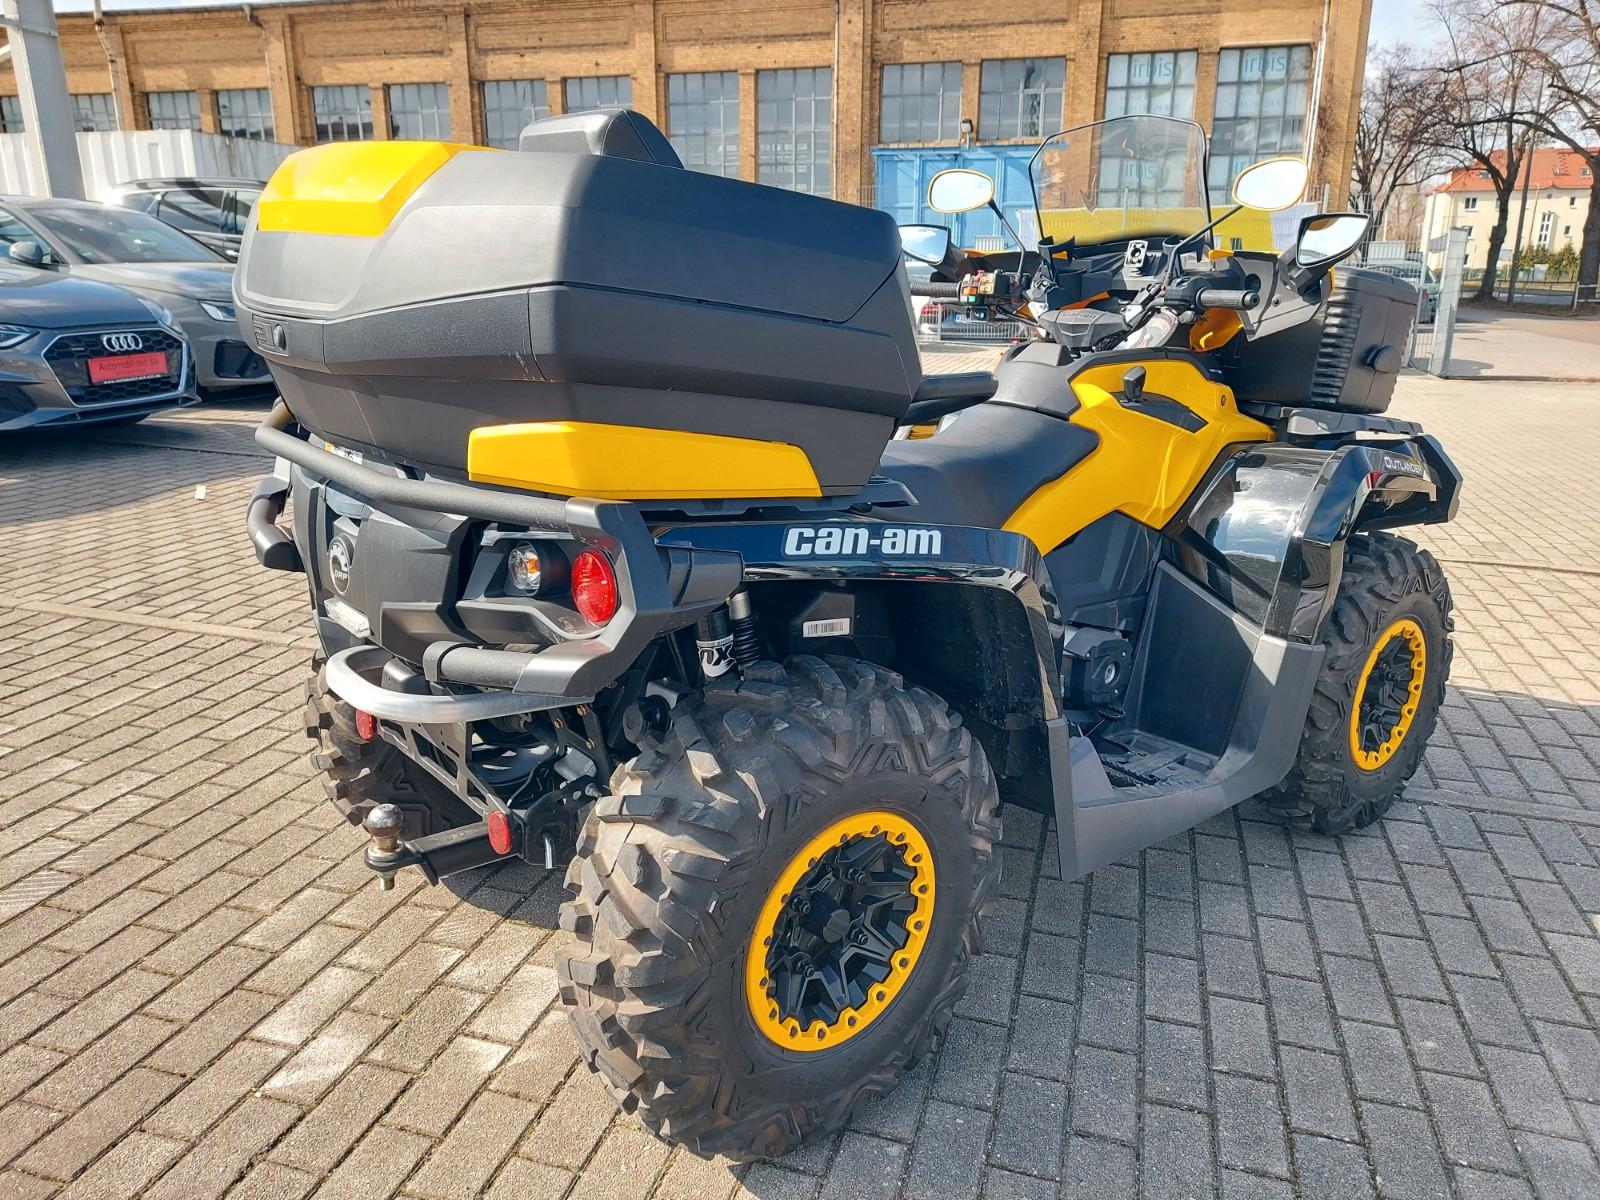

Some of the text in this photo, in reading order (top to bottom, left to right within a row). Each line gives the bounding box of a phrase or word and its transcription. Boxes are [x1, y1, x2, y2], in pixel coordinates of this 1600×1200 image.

[1133, 57, 1173, 78] irbis
[1244, 52, 1286, 73] irbis
[334, 569, 349, 581] BRP
